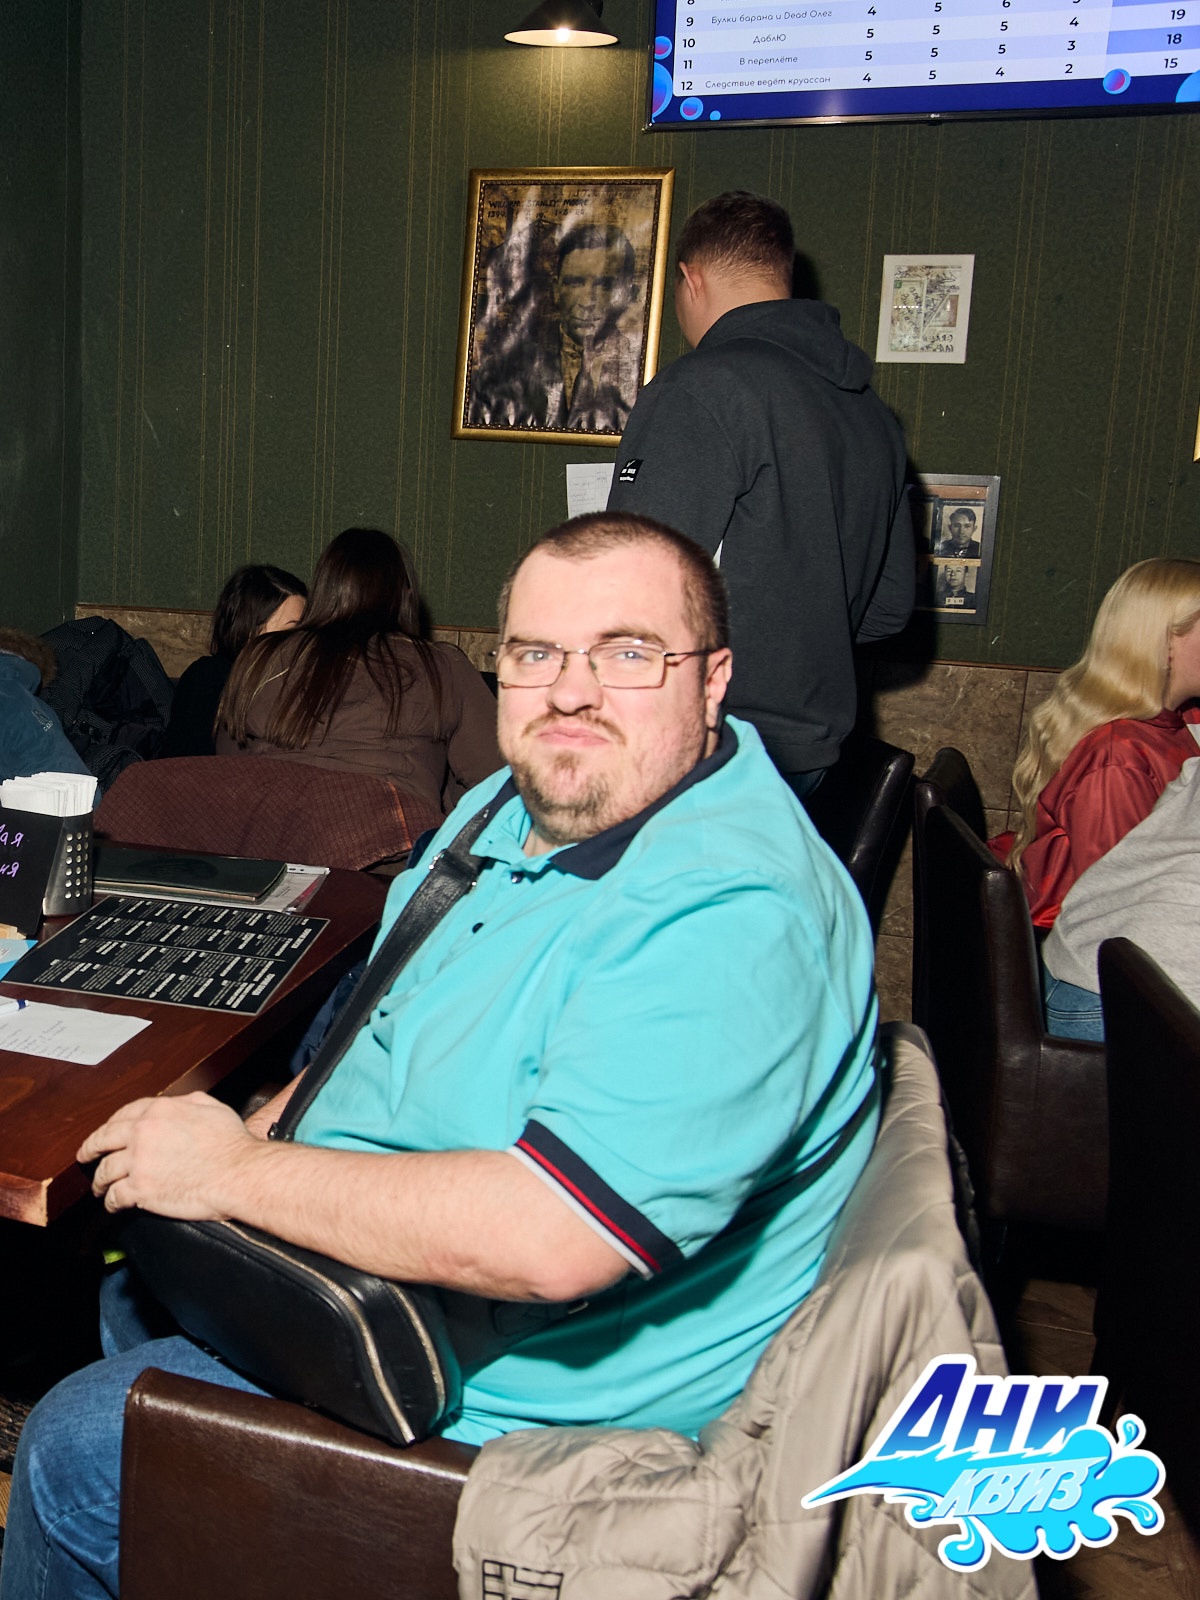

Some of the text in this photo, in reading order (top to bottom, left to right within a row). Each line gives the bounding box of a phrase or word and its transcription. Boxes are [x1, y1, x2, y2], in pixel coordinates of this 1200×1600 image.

[682, 8, 1186, 48] 10 ДаблЮ 5 5 5 4 19
[686, 17, 694, 27] 9
[711, 14, 737, 24] Булки
[784, 11, 807, 20] Dead
[809, 9, 833, 18] Олег
[867, 6, 877, 16] 4
[934, 2, 942, 12] 5
[683, 59, 693, 69] 11
[739, 57, 746, 66] В
[865, 51, 873, 61] 5
[930, 47, 939, 58] 5
[998, 44, 1006, 54] 5
[1067, 40, 1076, 51] 3
[1166, 33, 1182, 45] 18
[681, 80, 693, 91] 12
[705, 78, 755, 89] Следствие
[788, 75, 831, 86] круассан
[862, 73, 872, 83] 4
[928, 70, 937, 80] 5
[995, 66, 1005, 77] 4
[1065, 64, 1073, 74] 2
[1163, 58, 1179, 69] 15
